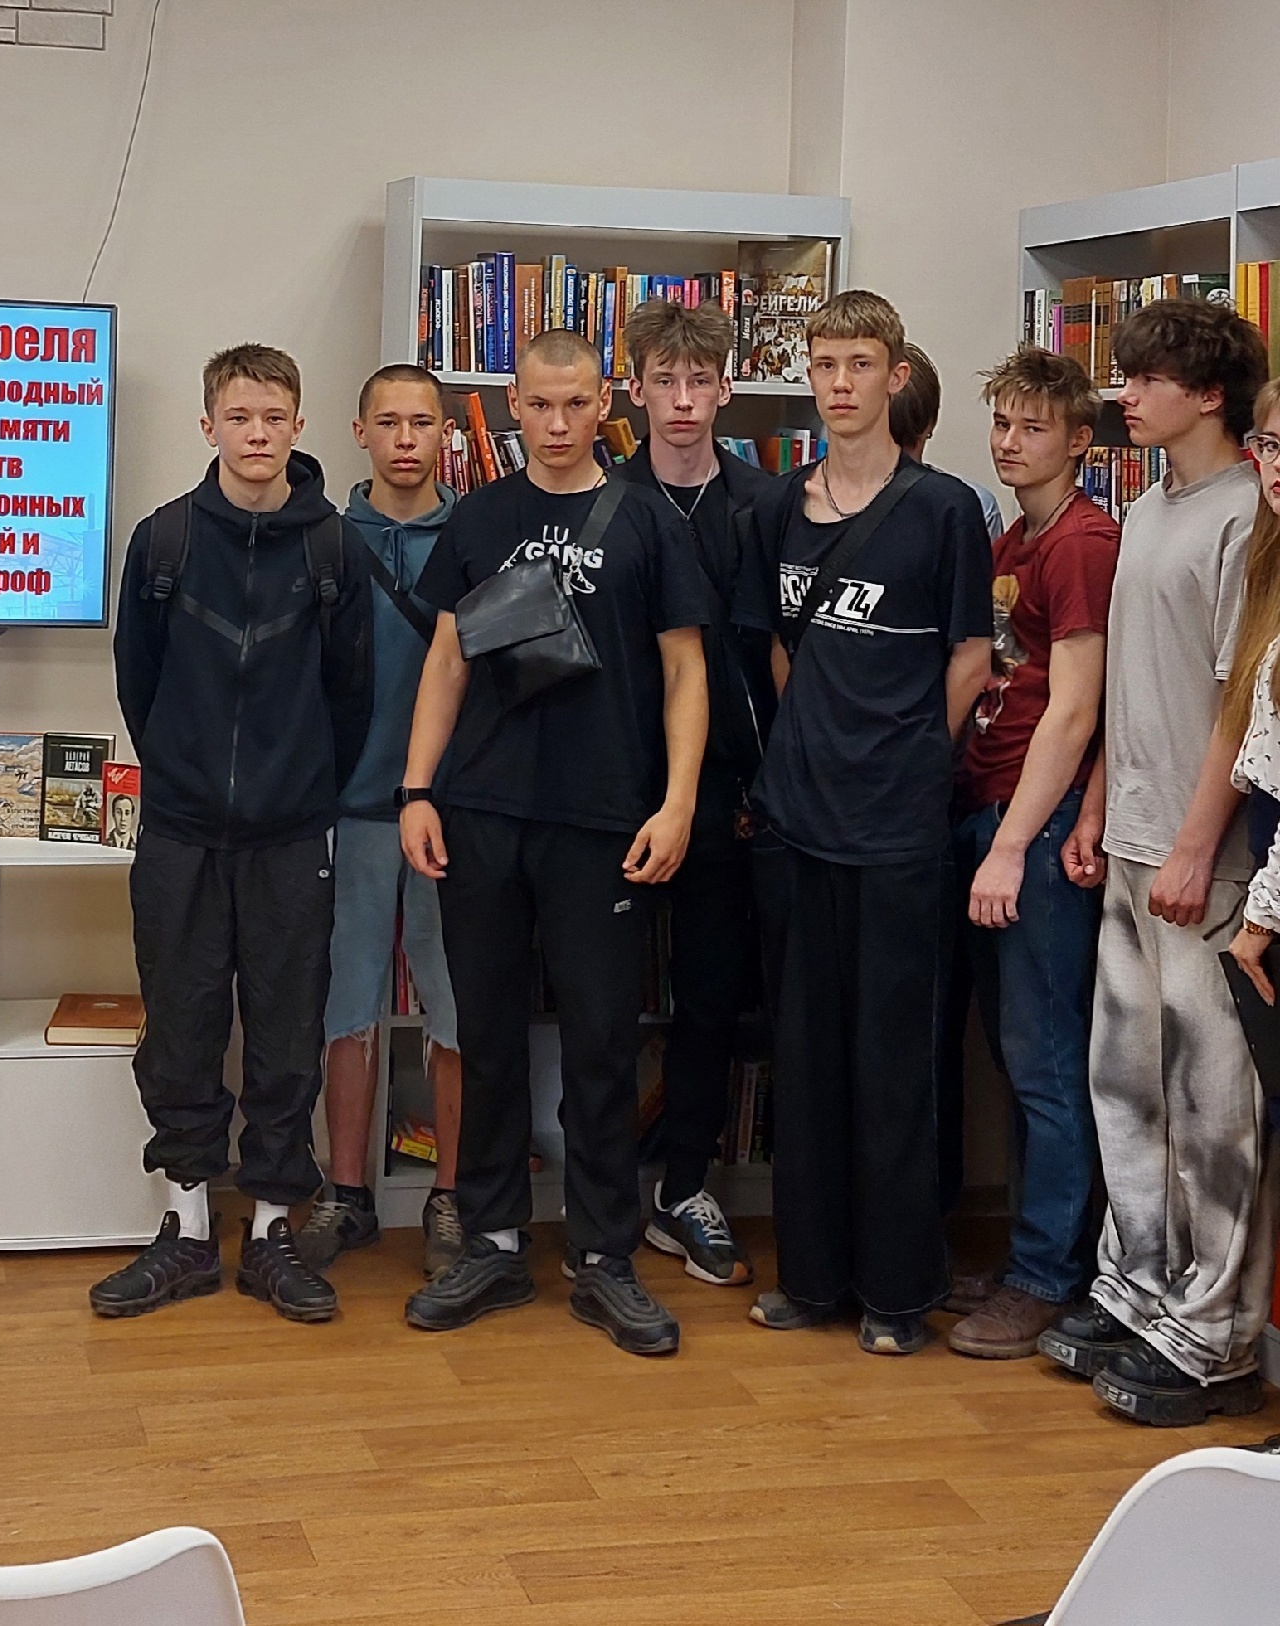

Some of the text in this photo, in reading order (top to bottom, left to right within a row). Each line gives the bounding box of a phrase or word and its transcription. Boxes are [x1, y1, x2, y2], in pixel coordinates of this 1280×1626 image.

[22, 534, 40, 555] и
[542, 525, 569, 545] LU
[63, 761, 91, 773] ЛЕГАСОВ
